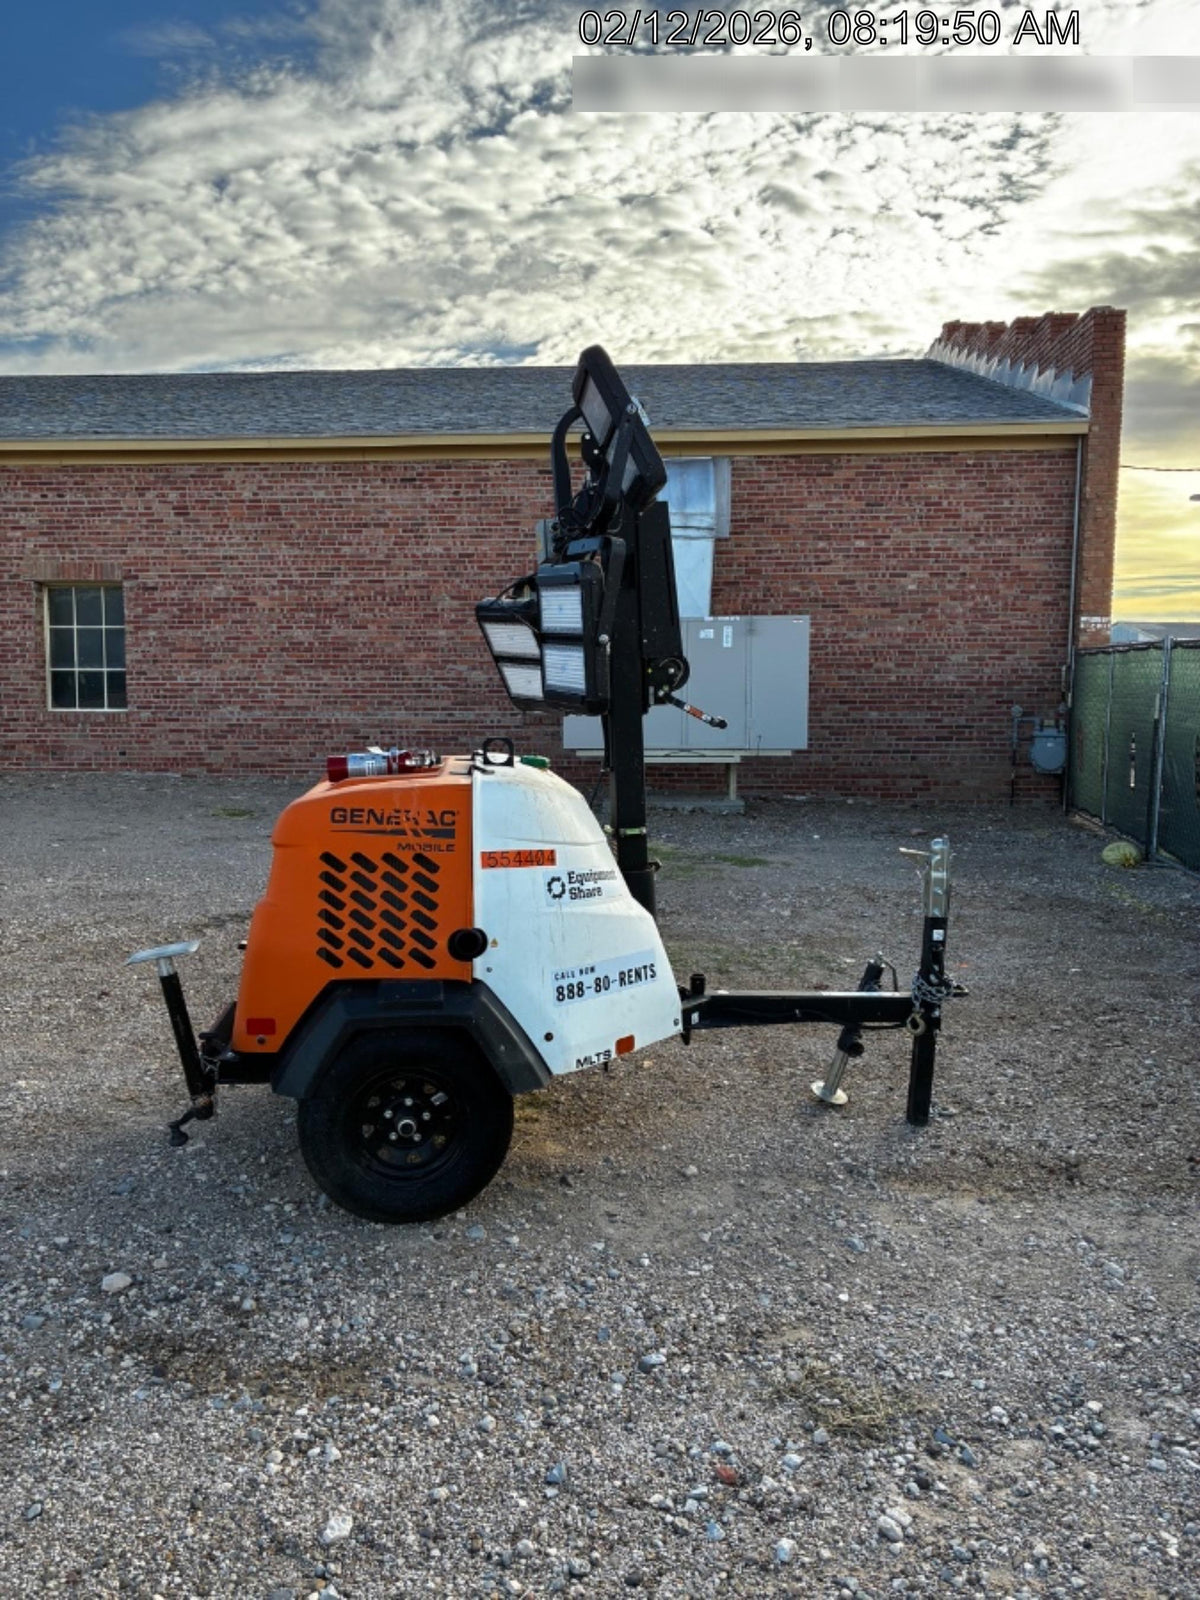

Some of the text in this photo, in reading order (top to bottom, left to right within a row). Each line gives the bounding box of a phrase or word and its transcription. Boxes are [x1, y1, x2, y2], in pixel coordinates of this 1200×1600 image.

[487, 849, 556, 868] 554404
[568, 886, 603, 900] Share
[556, 963, 657, 1001] 888-80-RENTS
